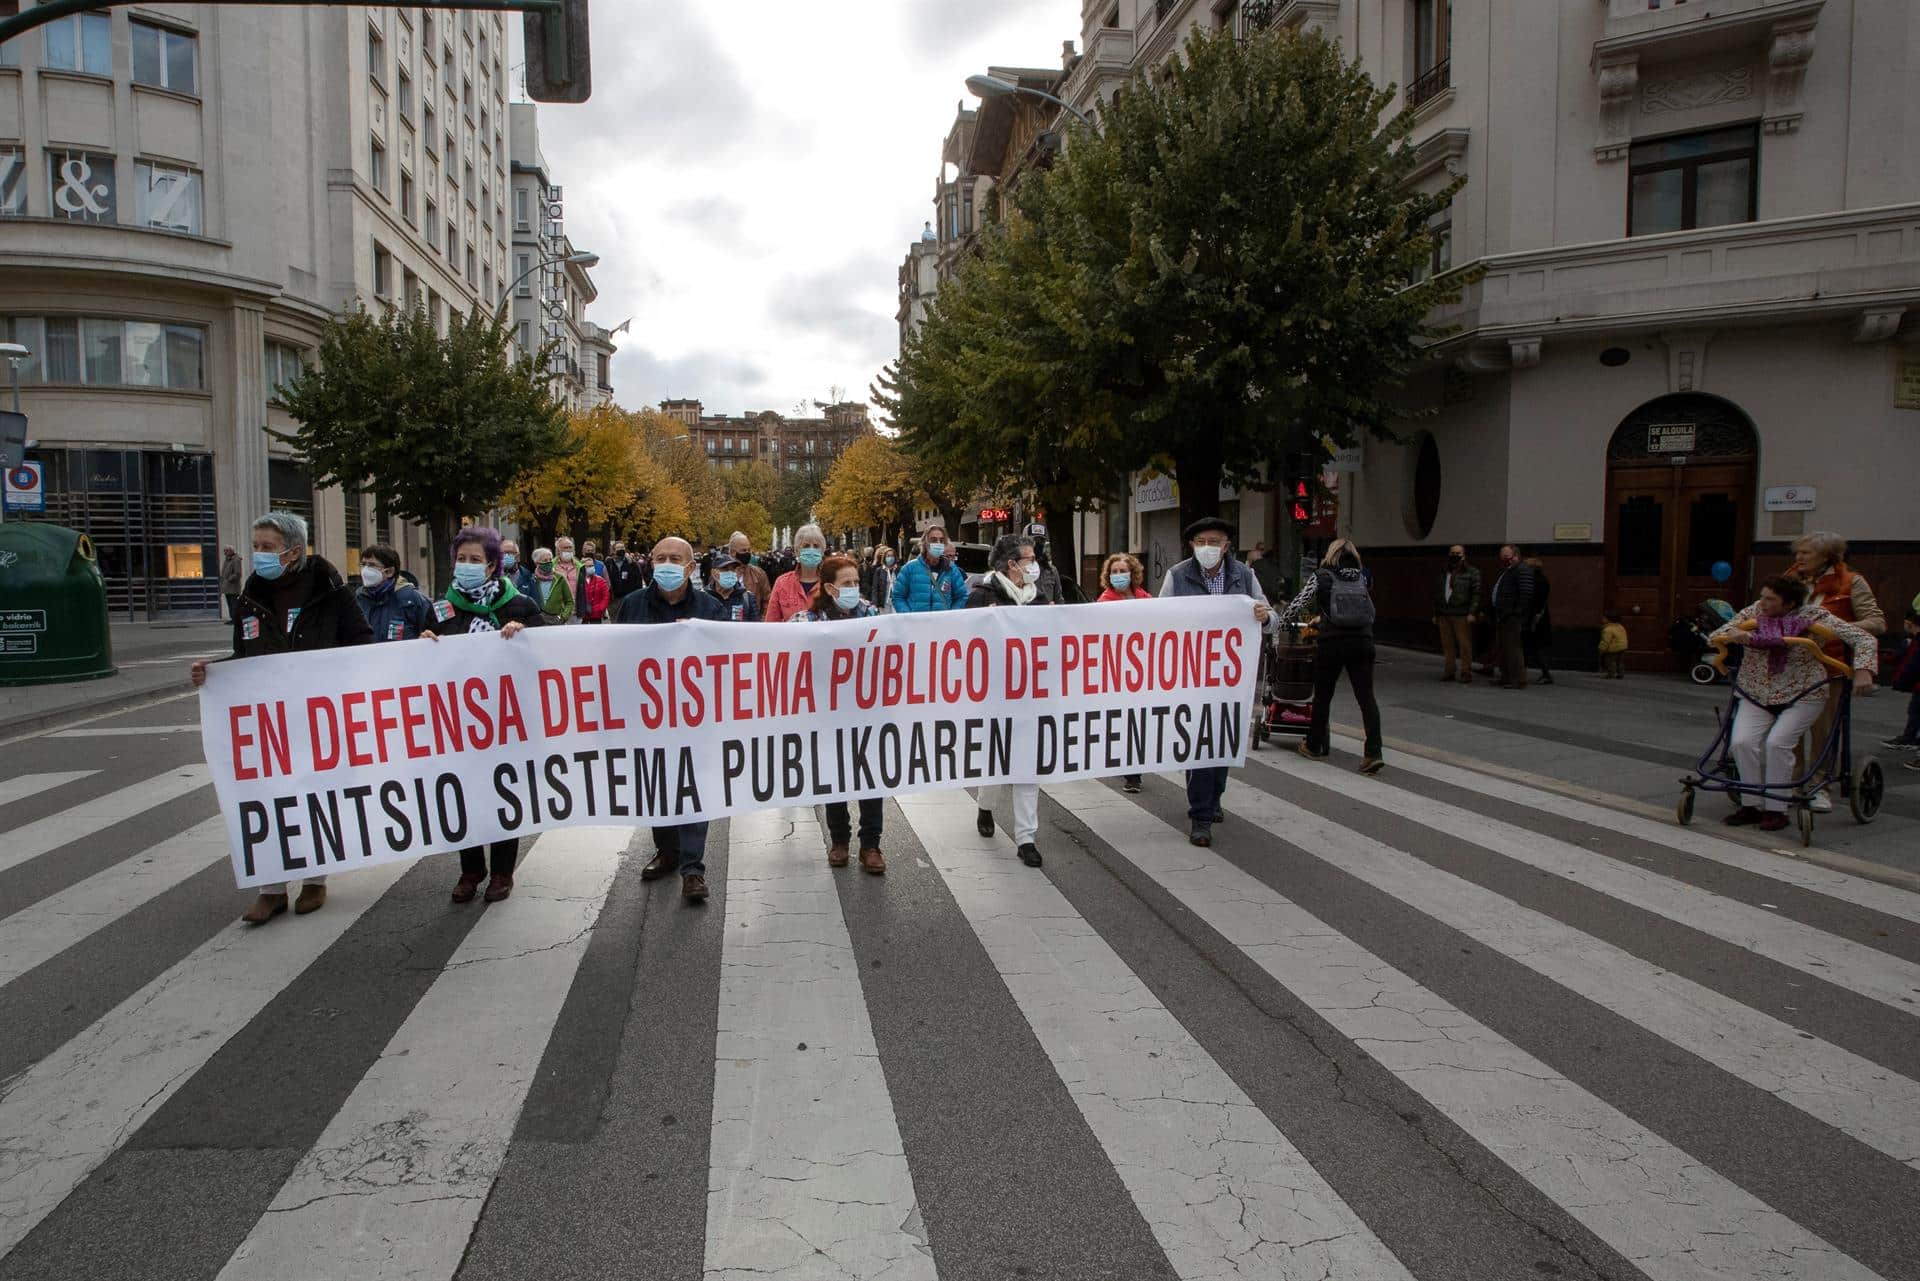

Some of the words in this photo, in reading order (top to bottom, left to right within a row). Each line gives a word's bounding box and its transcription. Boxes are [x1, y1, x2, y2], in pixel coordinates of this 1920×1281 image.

[56, 160, 109, 213] &
[150, 170, 192, 231] Z
[548, 186, 562, 272] HOTEL
[549, 287, 563, 373] YOLDI
[1662, 426, 1693, 434] ALQUILA
[6, 613, 33, 621] vidrio
[231, 702, 291, 779] EN
[308, 676, 527, 771] DEFENSA
[539, 665, 624, 736] DEL
[638, 650, 815, 729] SISTEMA
[831, 630, 988, 709] PÚBLICO
[1006, 637, 1048, 699] DE
[1062, 629, 1243, 695] PENSIONES
[240, 773, 468, 876] PENTSIO
[494, 747, 701, 831] SISTEMA
[723, 718, 1012, 806] PUBLIKOAREN
[1037, 702, 1240, 775] DEFENTSAN
